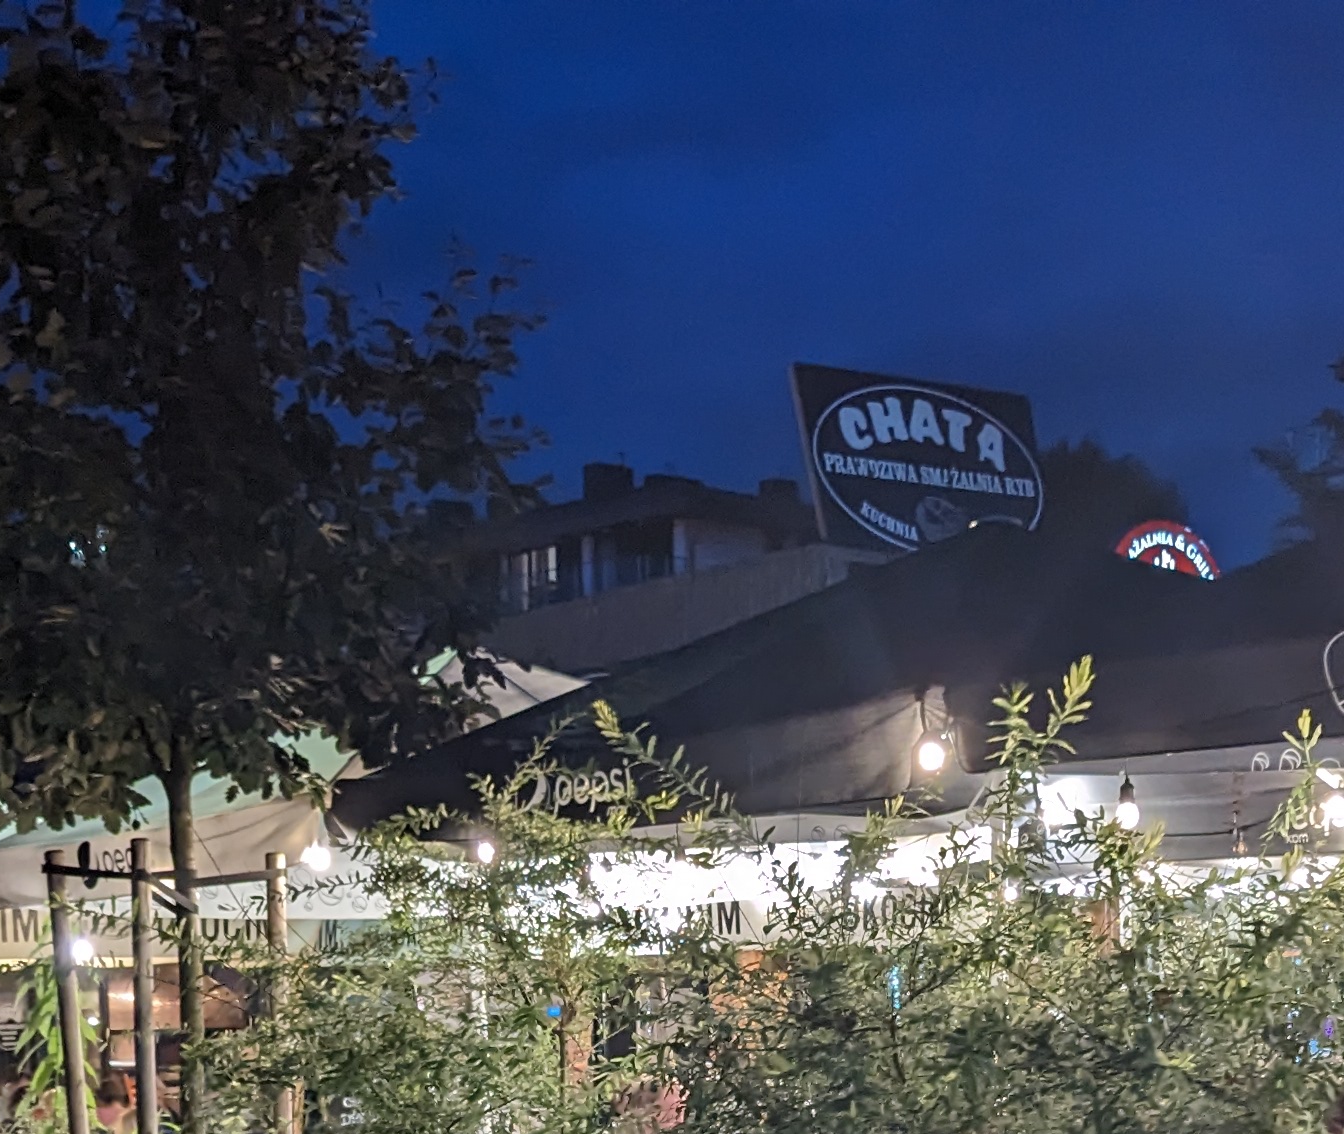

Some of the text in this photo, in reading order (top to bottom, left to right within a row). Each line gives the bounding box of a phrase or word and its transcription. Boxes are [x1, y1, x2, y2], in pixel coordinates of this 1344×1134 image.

[838, 396, 1006, 473] CHATA
[1004, 477, 1035, 498] RYB
[860, 500, 919, 541] KUCHNIA
[553, 757, 634, 816] pepsi
